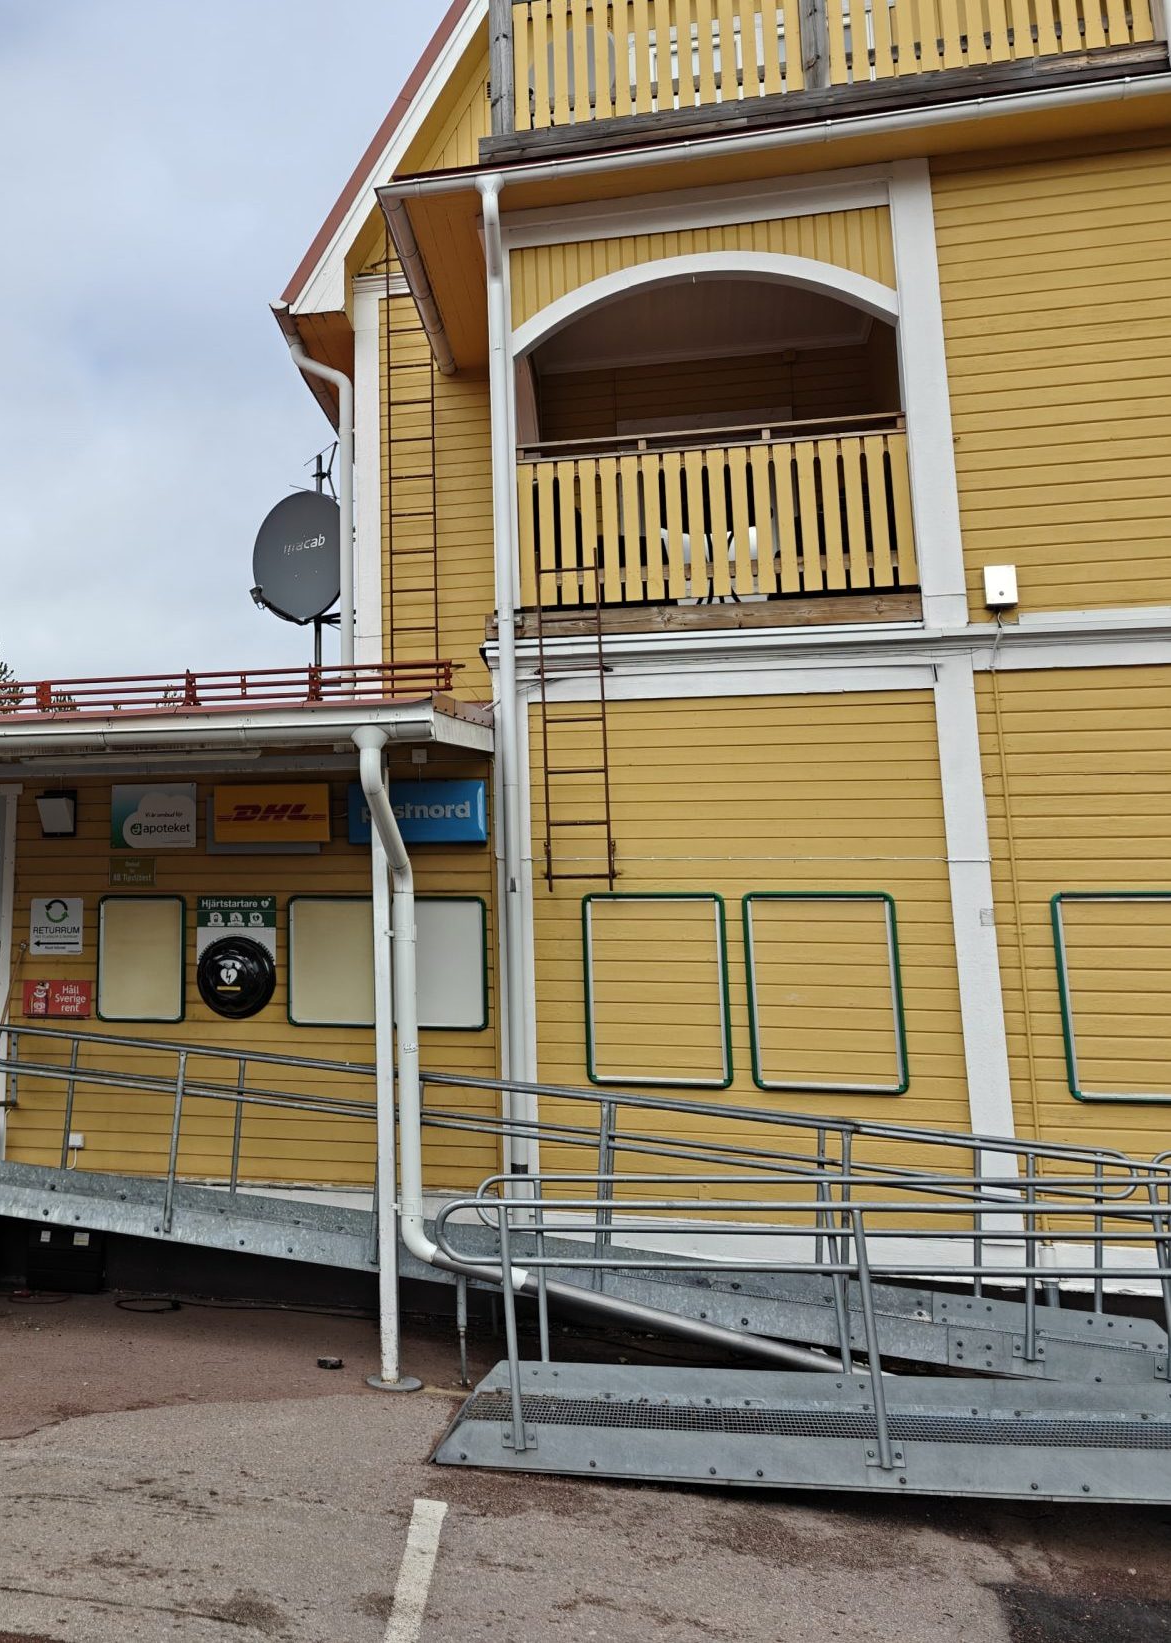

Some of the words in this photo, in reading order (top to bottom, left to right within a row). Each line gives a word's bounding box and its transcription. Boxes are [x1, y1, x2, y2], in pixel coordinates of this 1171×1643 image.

[230, 803, 309, 821] DHL
[361, 800, 471, 823] pstnord
[143, 822, 190, 835] apoteket
[201, 899, 258, 910] Hjärtstartare
[62, 984, 79, 994] Håll
[55, 993, 86, 1004] Sverige
[61, 1003, 80, 1012] rent
